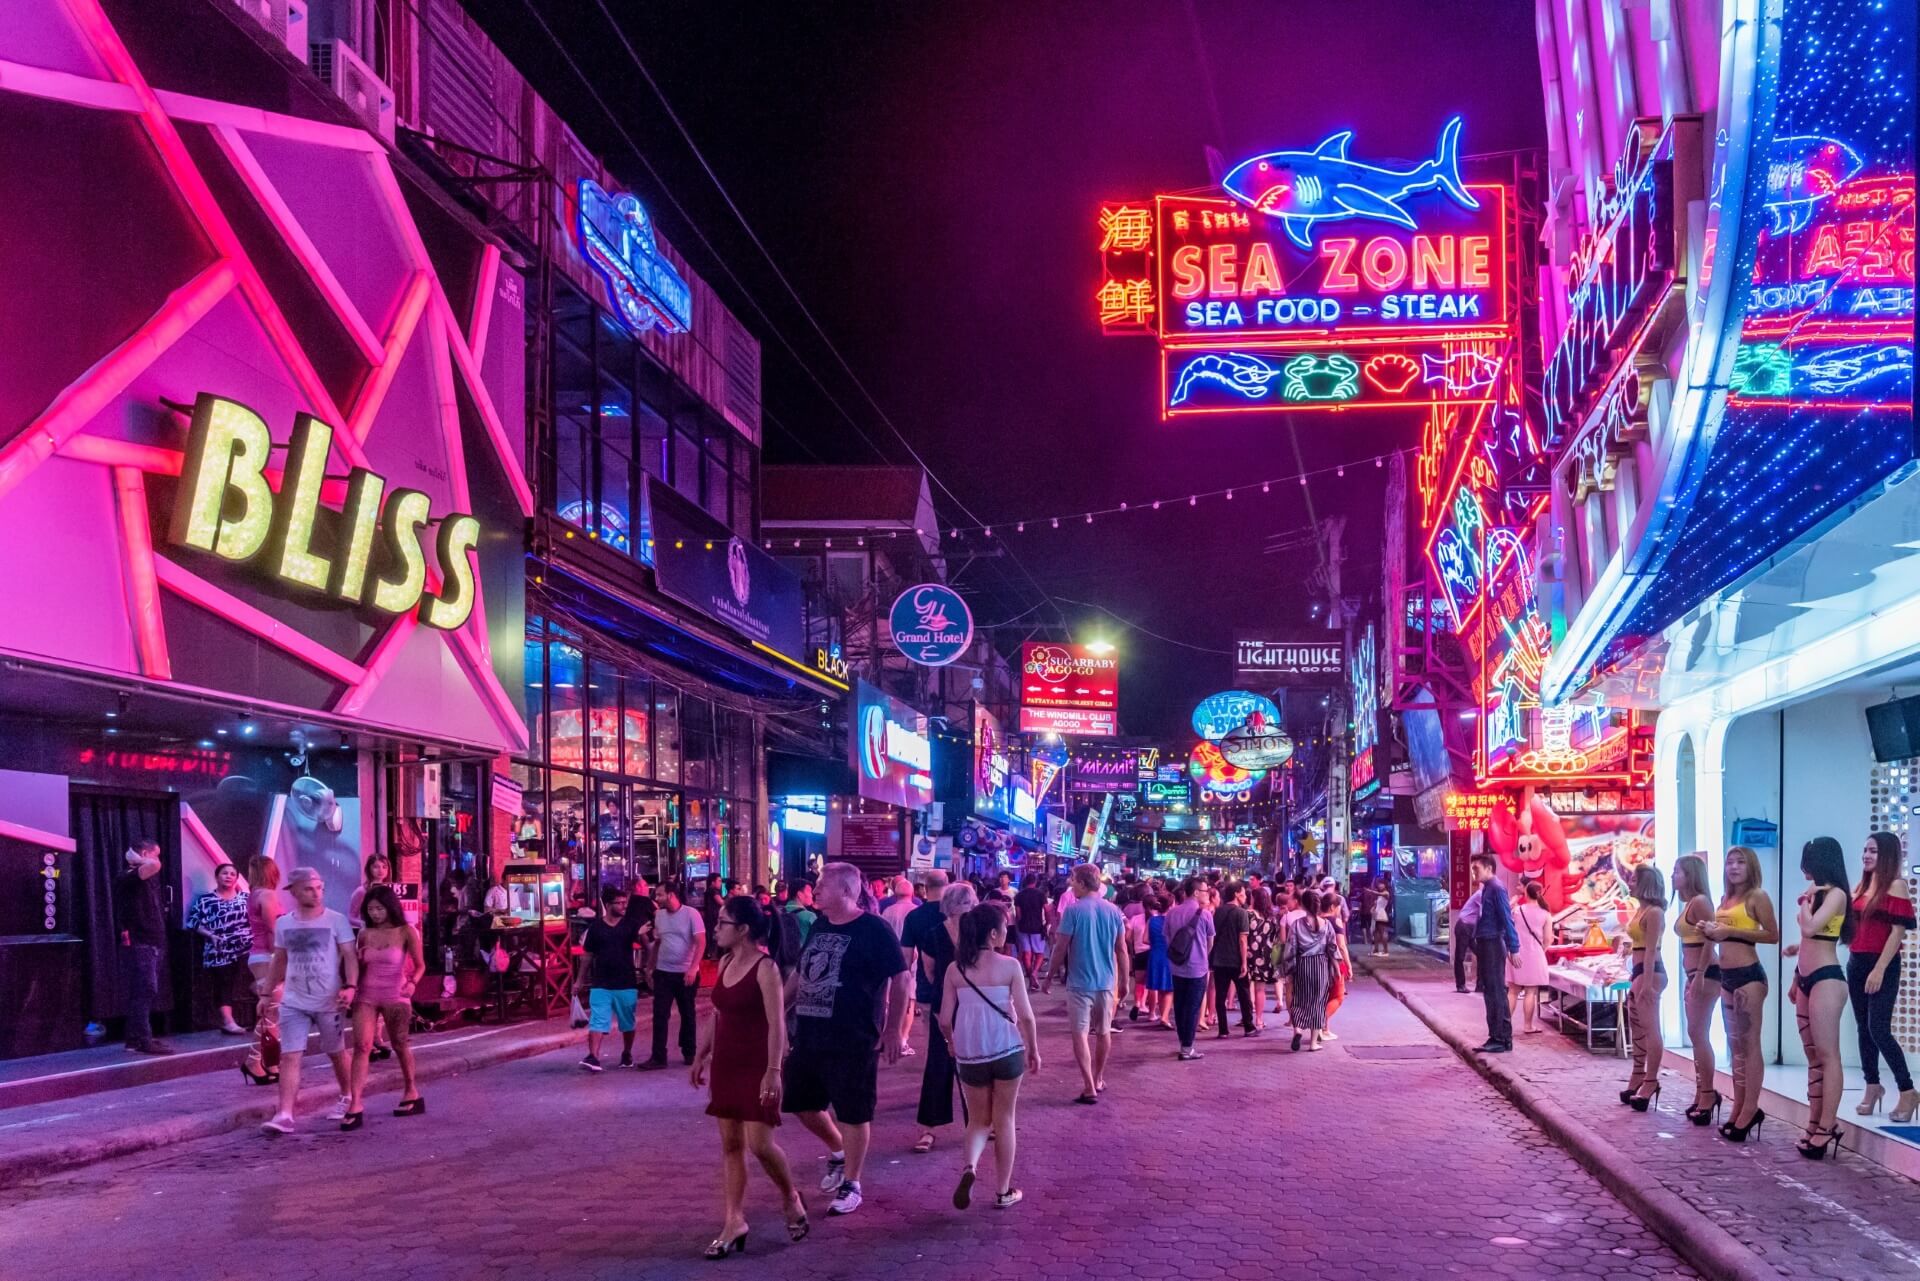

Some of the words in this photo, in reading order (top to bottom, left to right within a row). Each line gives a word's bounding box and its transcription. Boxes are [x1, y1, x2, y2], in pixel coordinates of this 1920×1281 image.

[1171, 242, 1286, 297] SEA
[1319, 235, 1491, 294] ZONE
[1185, 301, 1244, 326] SEA
[1257, 297, 1341, 325] FOOD
[1380, 293, 1480, 320] STEAK
[182, 393, 481, 630] BLISS
[896, 631, 930, 643] Grand
[933, 631, 964, 644] Hotel
[1049, 657, 1116, 669] SUGARBABY
[1237, 648, 1342, 665] LIGHTHOUSE
[817, 649, 849, 680] BLACK
[1047, 665, 1094, 676] AGO-GO
[1026, 697, 1054, 705] PATTAYA
[1029, 710, 1045, 718] THE
[1047, 711, 1087, 720] WINDMILL
[1089, 713, 1112, 721] CLUB
[1052, 720, 1080, 728] AGOGO
[1226, 736, 1290, 753] SIMON
[1080, 759, 1129, 774] MIAMI
